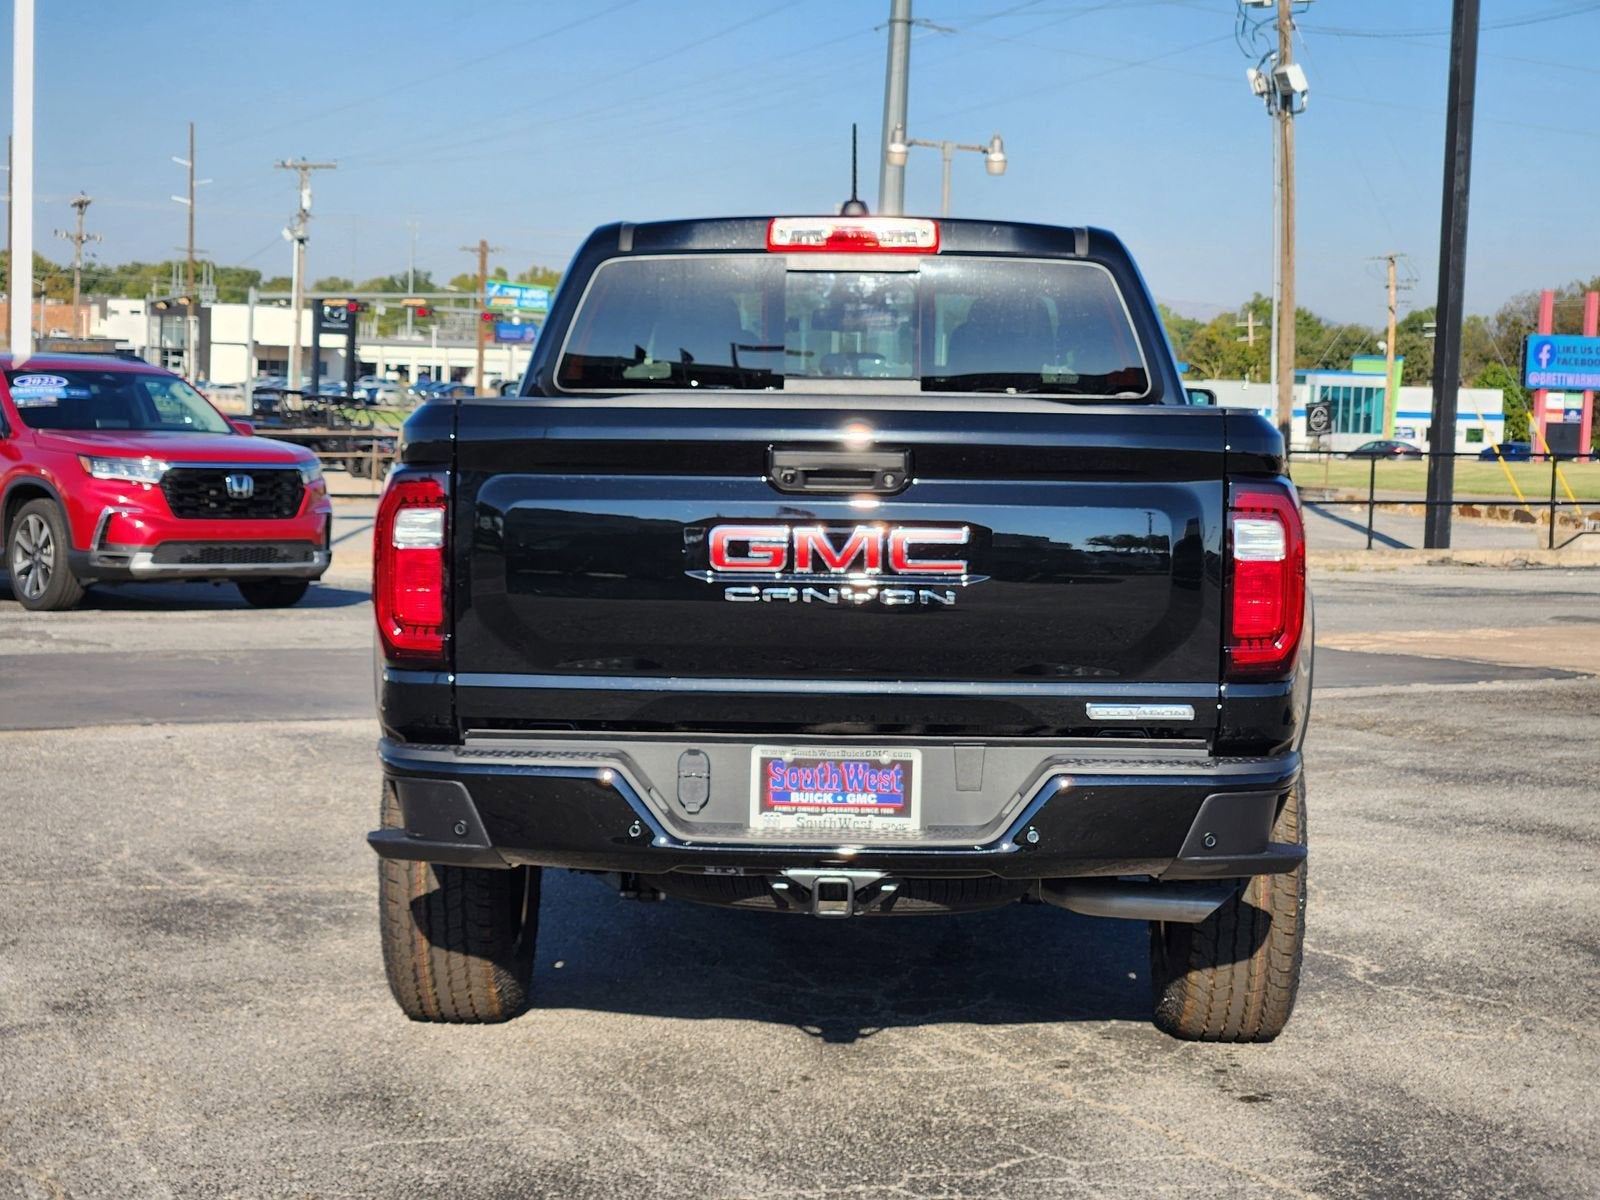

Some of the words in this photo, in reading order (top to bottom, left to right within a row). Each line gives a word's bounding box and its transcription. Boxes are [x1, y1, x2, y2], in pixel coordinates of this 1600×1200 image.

[1557, 344, 1577, 354] LIKE
[1580, 345, 1593, 355] US
[709, 525, 970, 573] GMC
[724, 586, 957, 605] CANYON
[790, 792, 833, 804] BUICK
[846, 793, 878, 804] GMC
